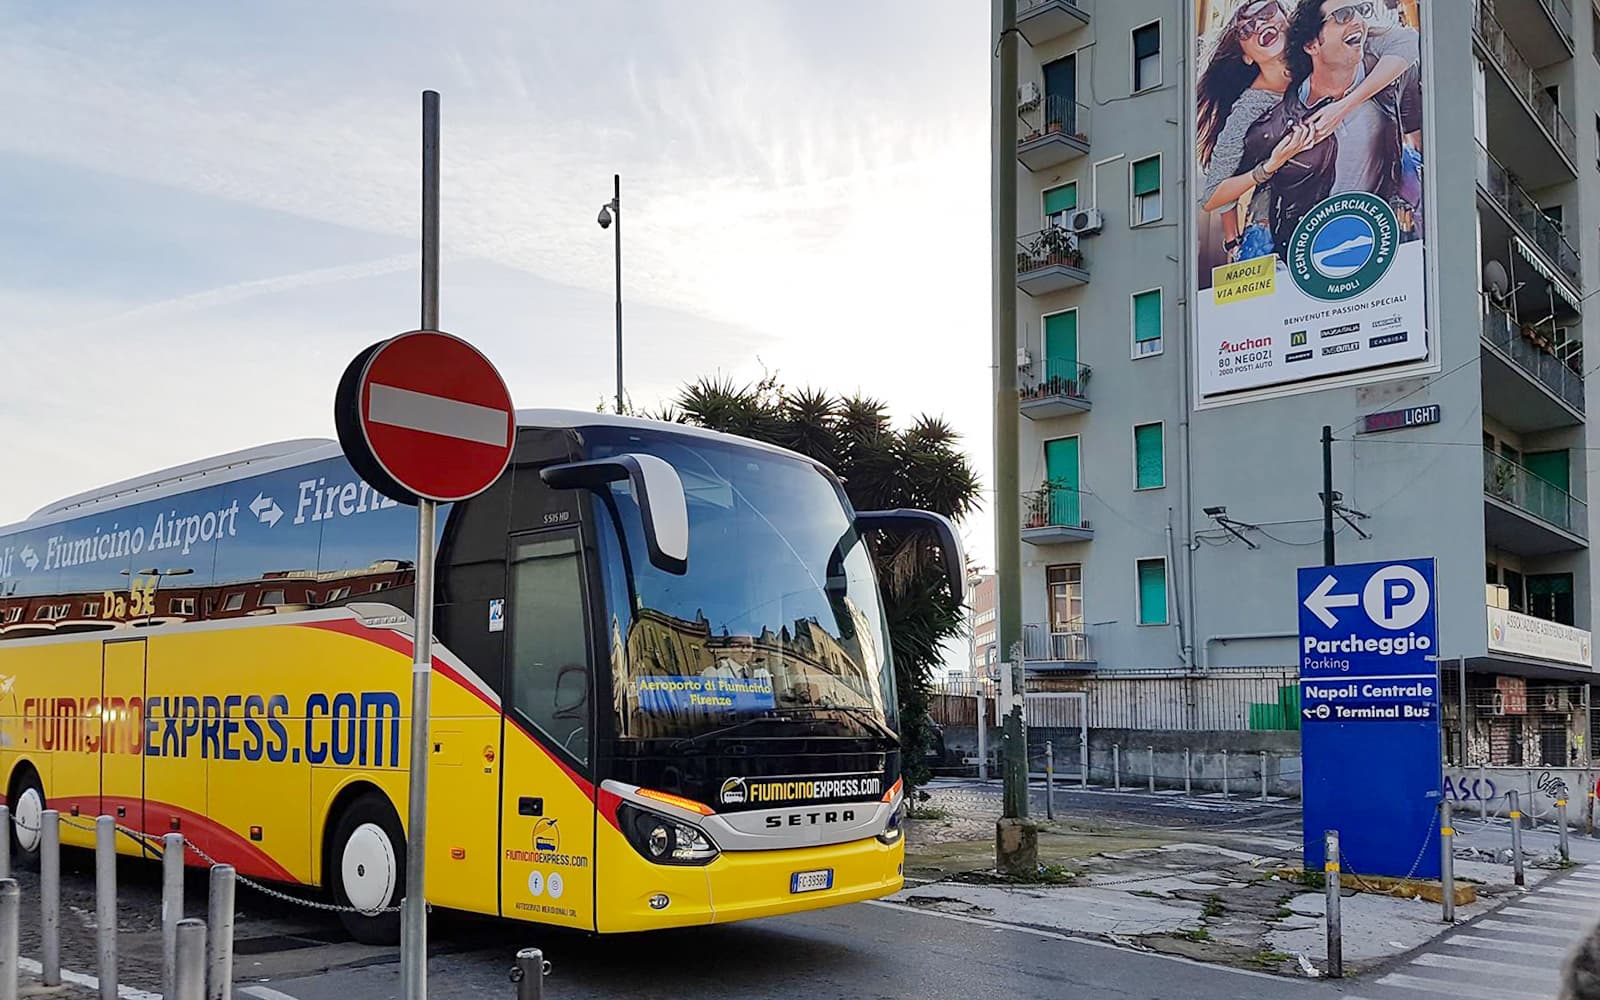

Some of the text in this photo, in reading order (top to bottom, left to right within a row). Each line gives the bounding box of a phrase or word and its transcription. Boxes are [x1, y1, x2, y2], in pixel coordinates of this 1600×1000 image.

[1295, 199, 1391, 275] CENTRO COMMERCIALE AUCHAN
[1226, 265, 1261, 280] NAPOLI
[1217, 279, 1272, 298] VIA ARGINE
[1327, 279, 1360, 293] NAPOLI
[1284, 295, 1407, 326] BENVENUTE PASSIONI SPECIALI
[1218, 337, 1272, 355] Auchan
[1218, 358, 1230, 368] 80
[1234, 350, 1272, 365] NEGOZI
[1219, 361, 1272, 376] 2000 POSTI AUTO
[44, 499, 239, 570] Fiumicino Airport
[102, 590, 126, 619] Da
[1304, 632, 1431, 655] Parcheggio
[1304, 656, 1350, 671] Parking
[640, 679, 772, 694] Aeroporto di Fiumicino
[1305, 683, 1432, 701] Napoli Centrale
[690, 693, 732, 706] Firenze
[1335, 704, 1430, 718] Terminal Bus
[766, 810, 855, 828] SETRA
